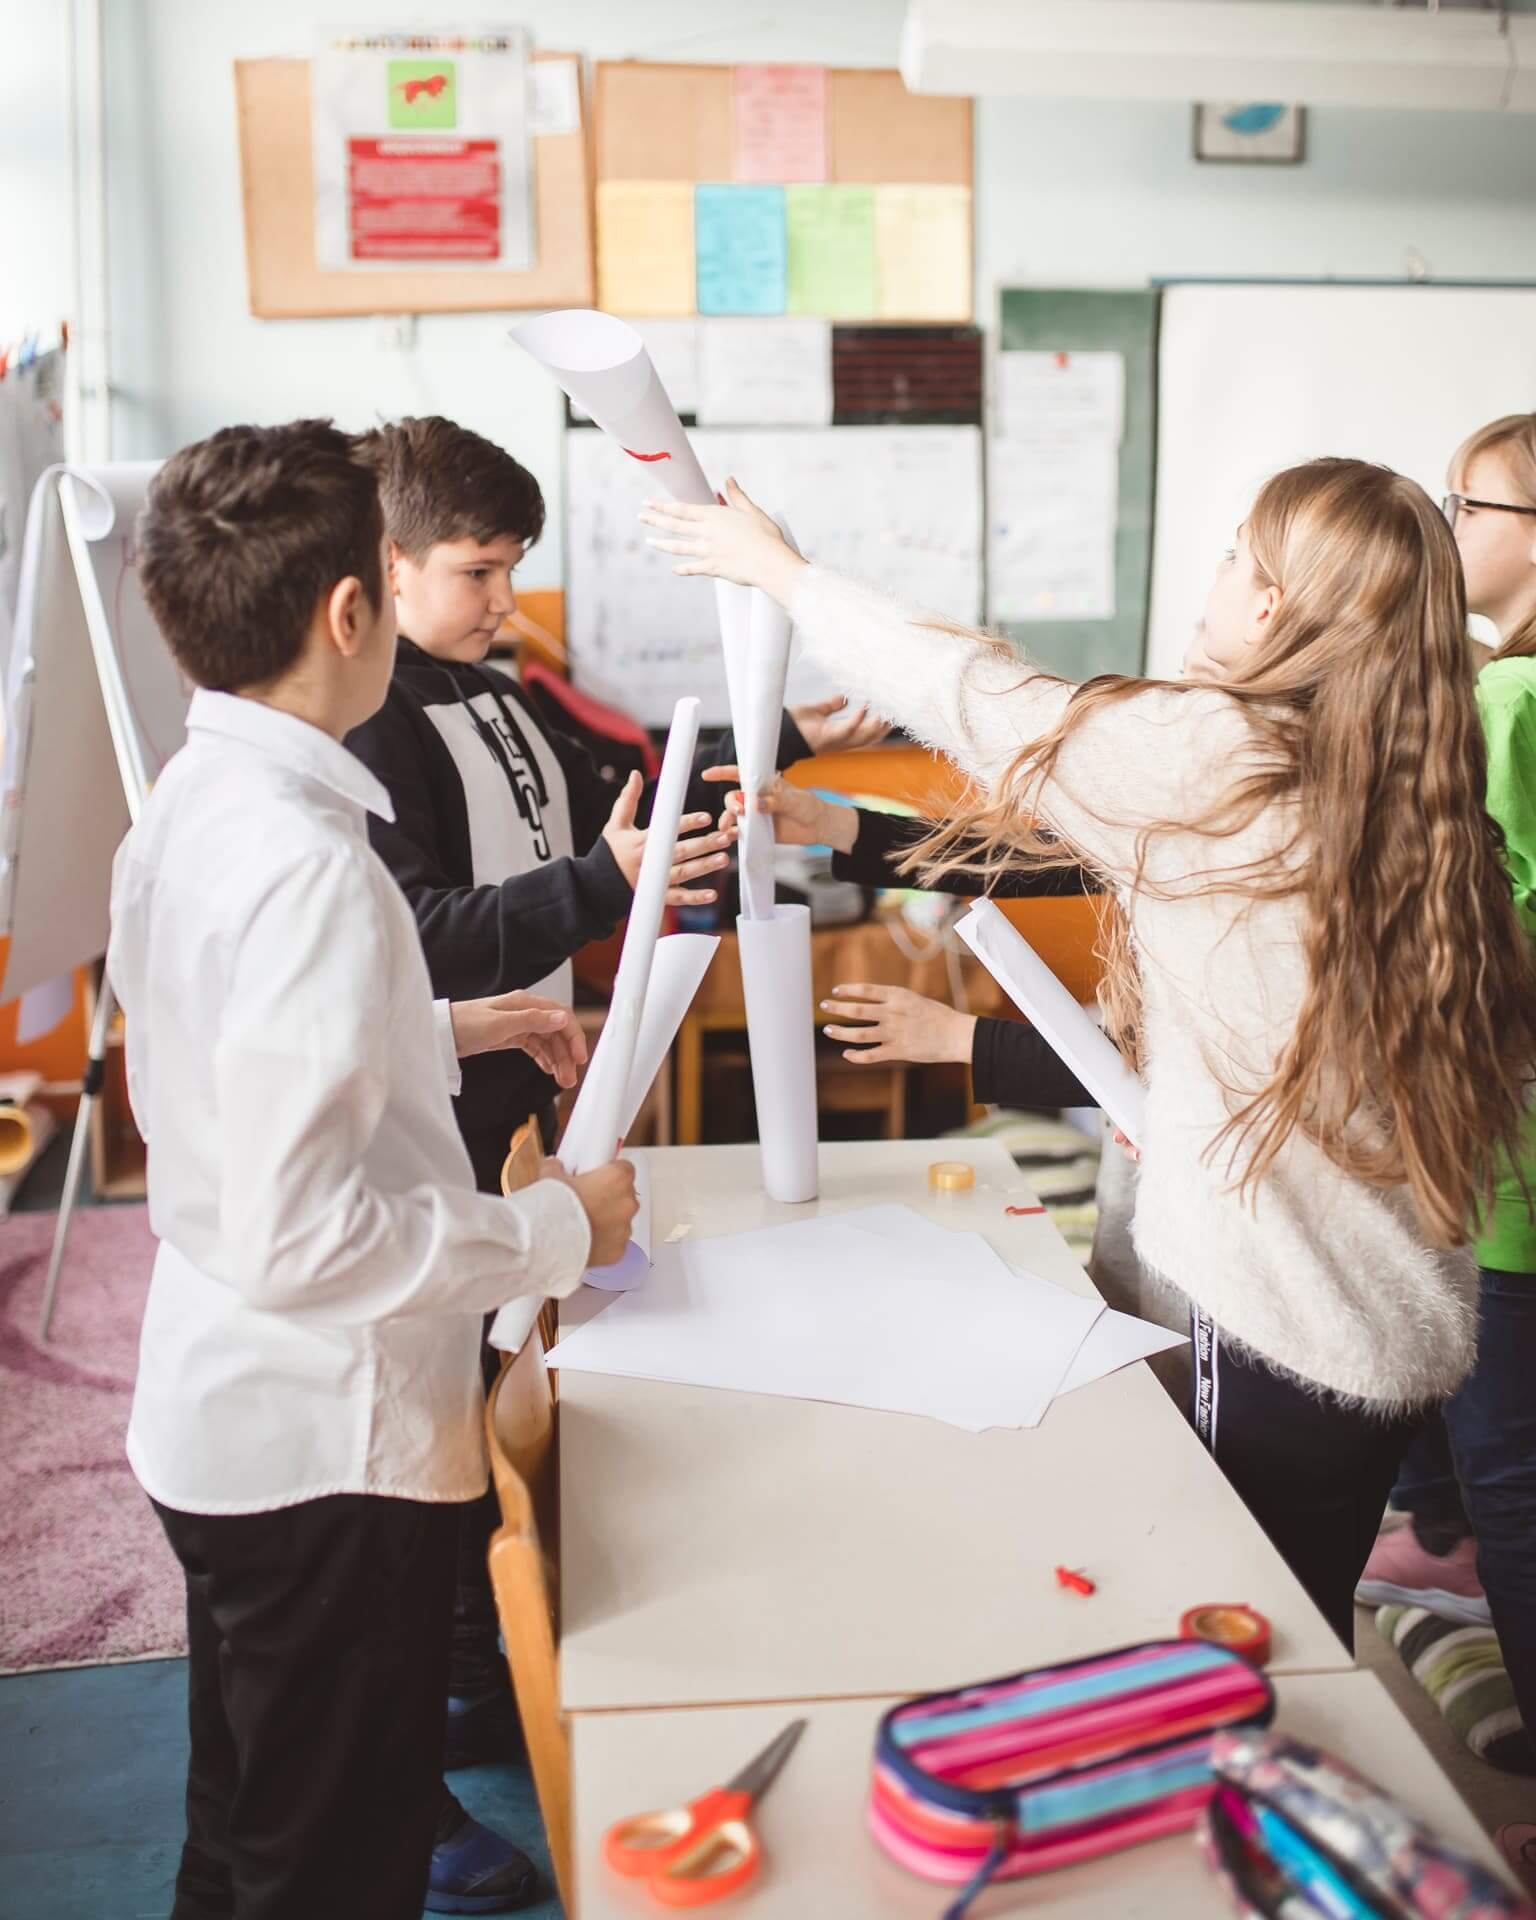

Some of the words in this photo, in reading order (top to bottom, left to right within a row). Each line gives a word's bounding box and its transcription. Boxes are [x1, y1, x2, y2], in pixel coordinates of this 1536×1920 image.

[1199, 1323, 1212, 1362] Fashion
[1199, 1376, 1212, 1402] New
[1199, 1399, 1212, 1439] Fashion
